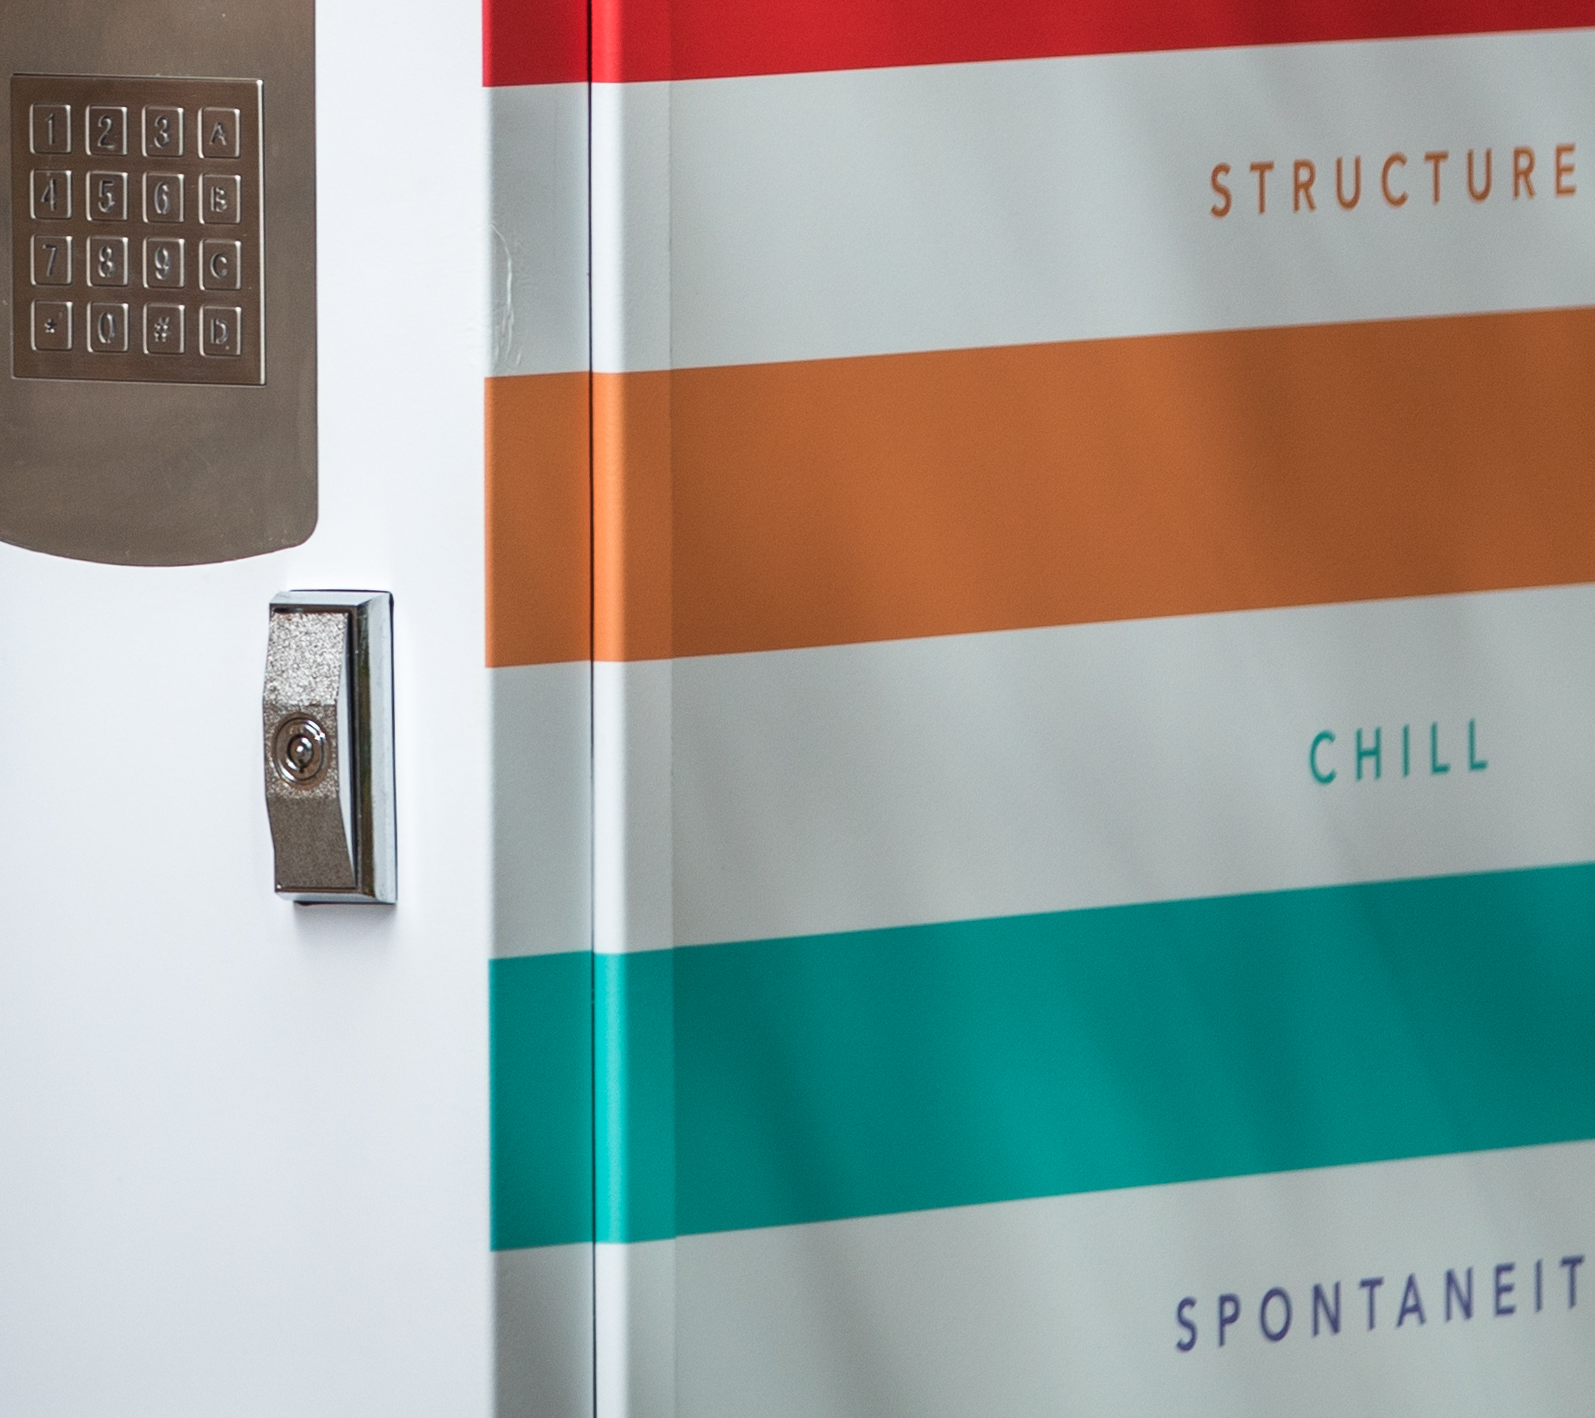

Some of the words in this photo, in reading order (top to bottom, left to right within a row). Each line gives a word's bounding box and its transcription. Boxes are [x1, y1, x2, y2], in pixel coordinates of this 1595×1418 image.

[45, 113, 57, 147] 1
[96, 114, 116, 150] 2
[153, 114, 171, 149] 3
[209, 120, 228, 147] A
[40, 178, 58, 212] 4
[97, 179, 116, 214] 5
[153, 181, 171, 215] 6
[210, 186, 229, 213] B
[1210, 143, 1578, 218] STRUCTURE
[41, 243, 58, 278] 7
[98, 245, 115, 279] 8
[154, 246, 171, 281] 9
[209, 252, 229, 280] C
[97, 312, 116, 345] 0
[210, 317, 229, 345] D
[1308, 718, 1489, 785] CHILL
